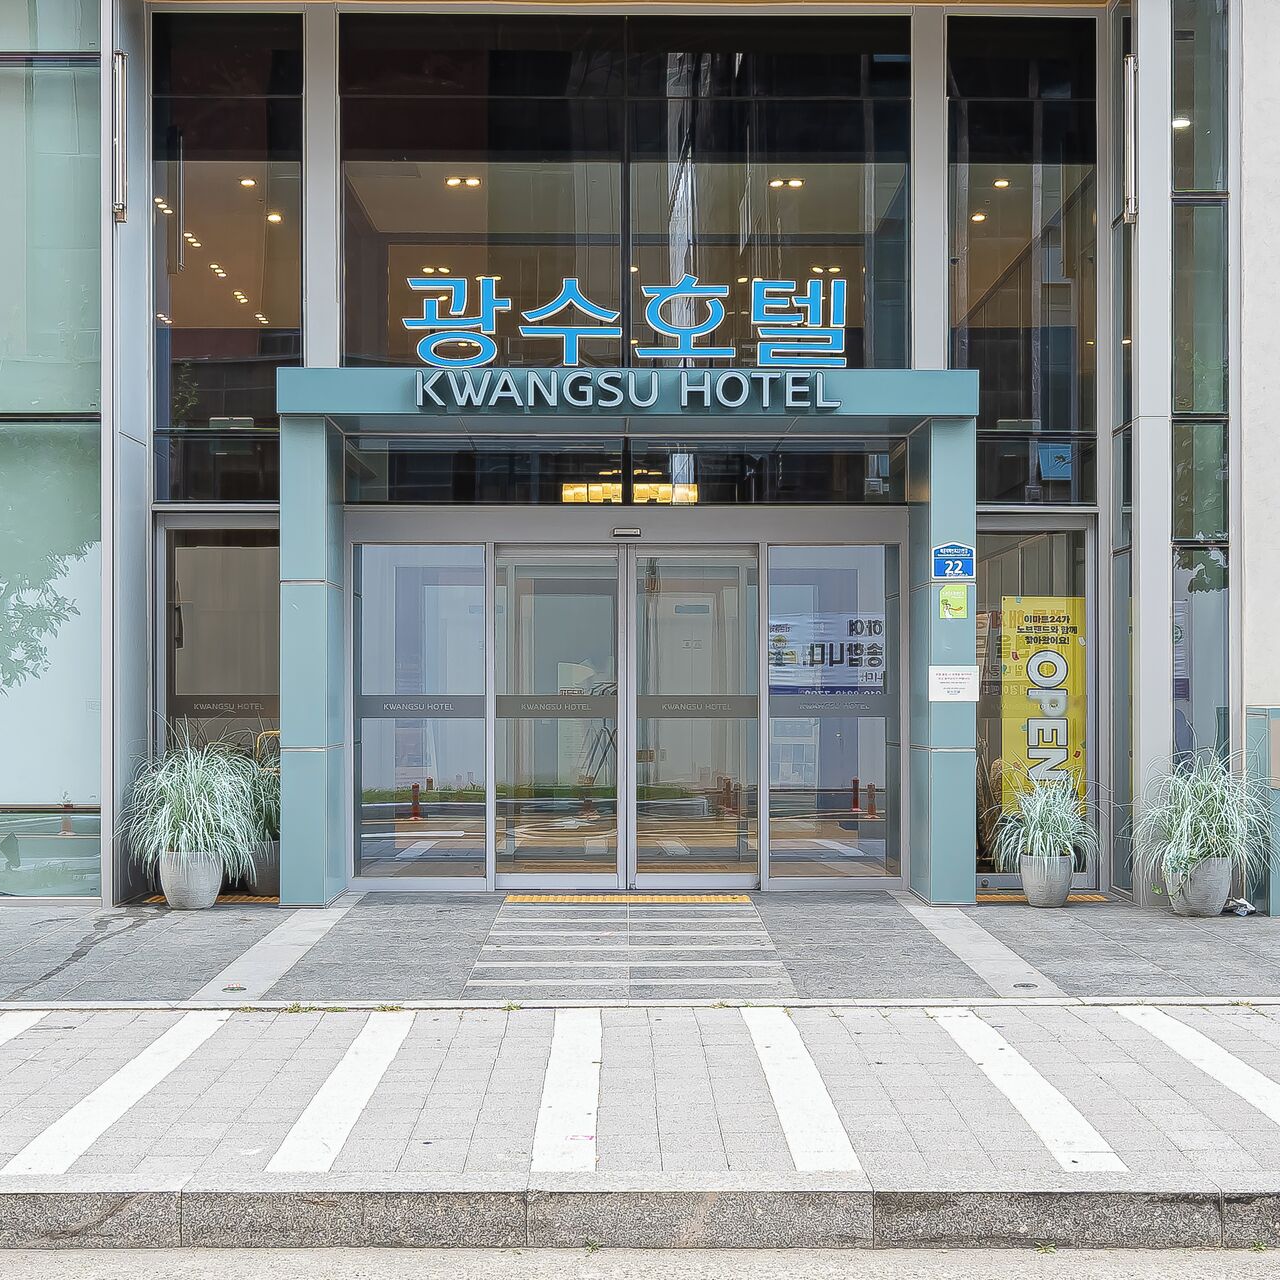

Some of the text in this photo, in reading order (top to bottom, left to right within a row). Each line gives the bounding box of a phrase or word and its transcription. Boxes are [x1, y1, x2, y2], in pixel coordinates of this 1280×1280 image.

[401, 274, 848, 369] 광수호텔
[415, 369, 844, 408] KWANGSU HOTEL
[944, 560, 963, 574] 22
[1026, 649, 1069, 781] OPEN
